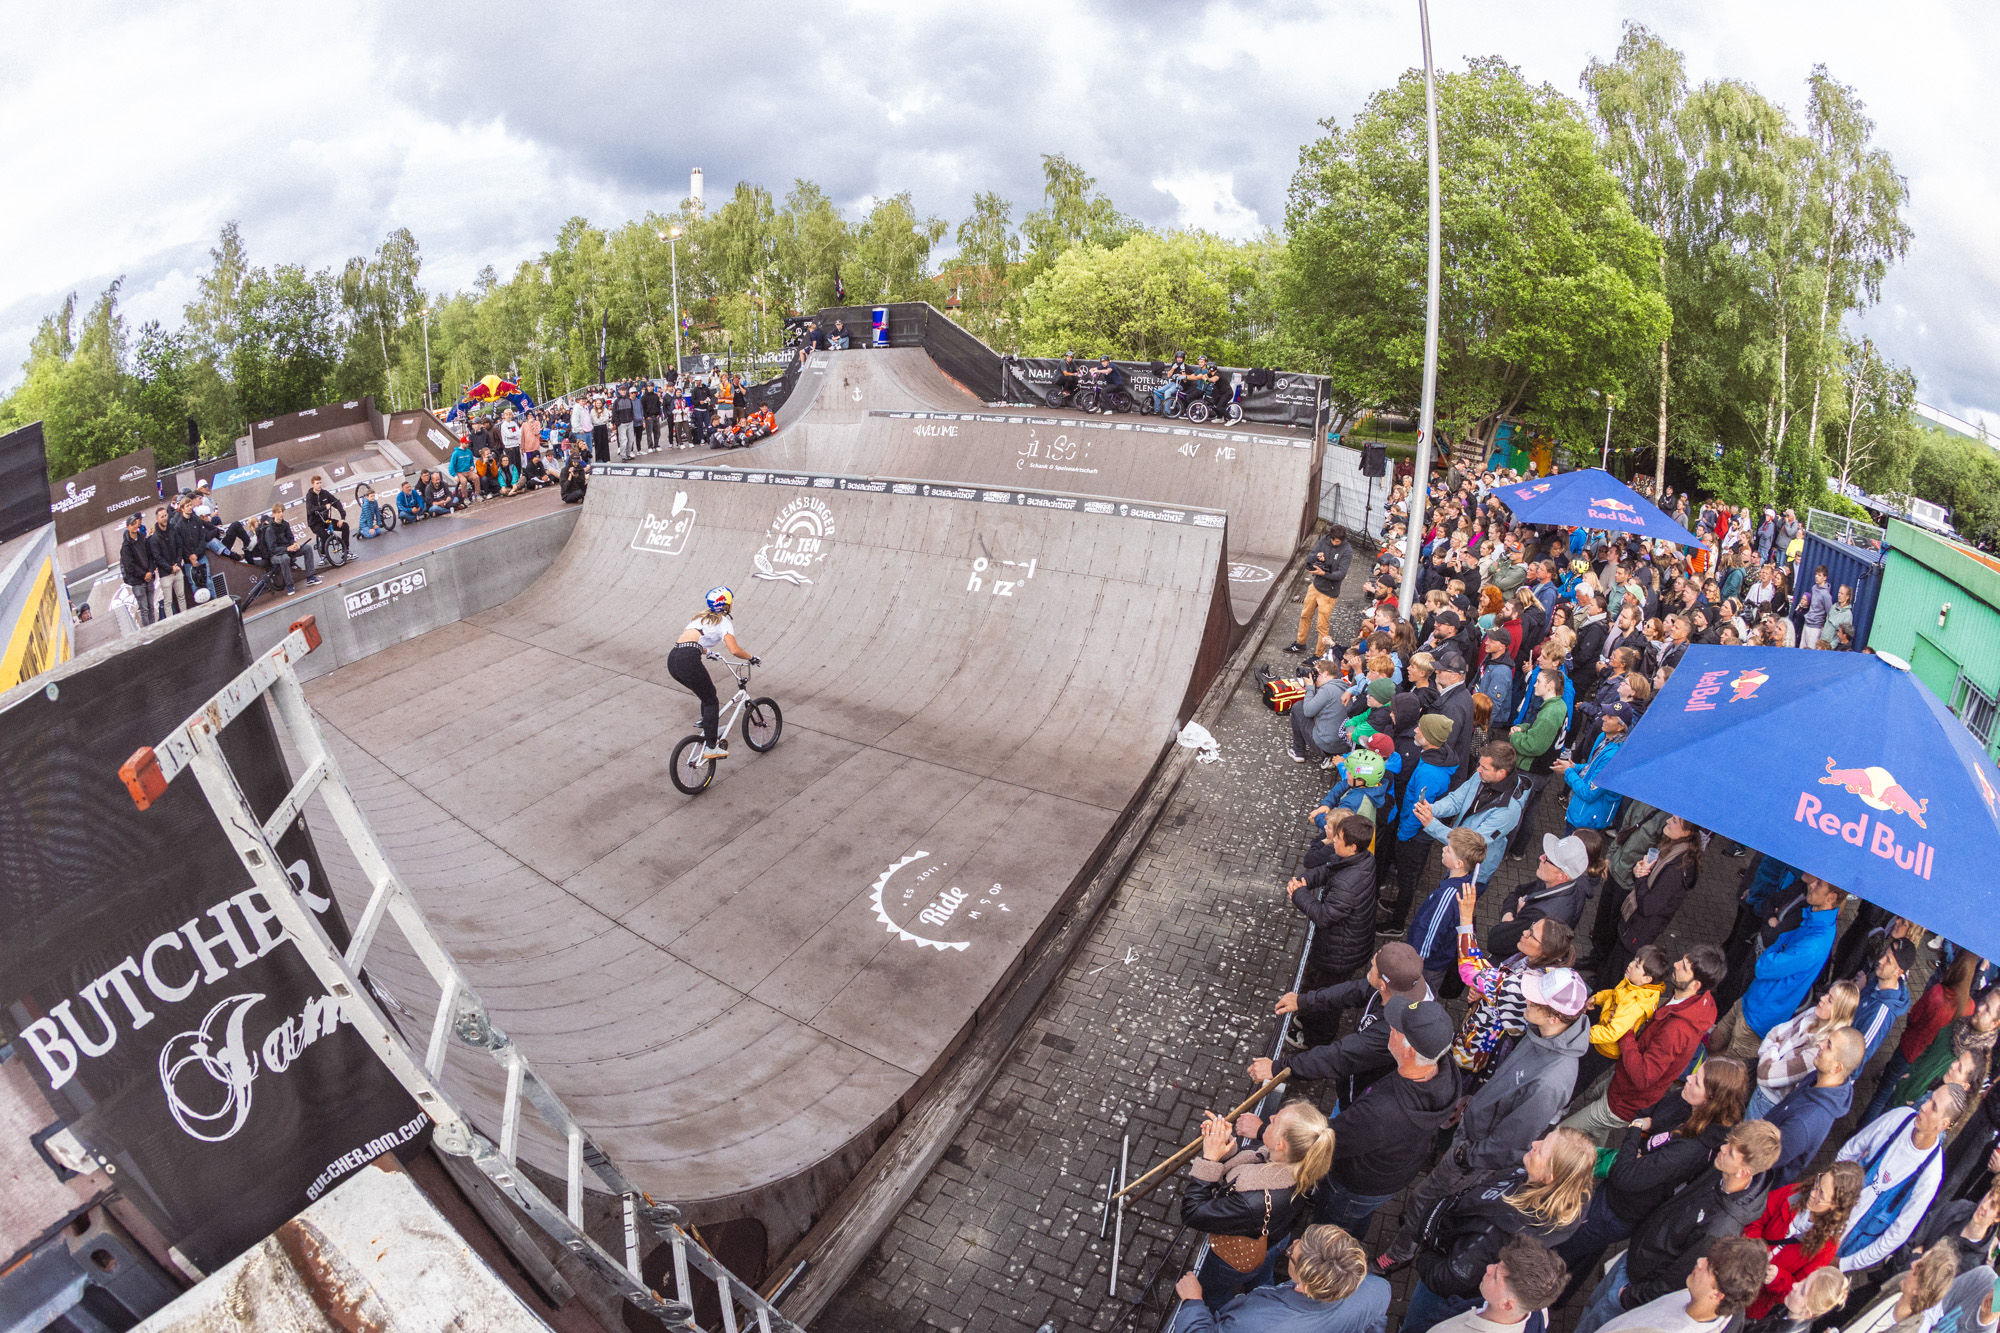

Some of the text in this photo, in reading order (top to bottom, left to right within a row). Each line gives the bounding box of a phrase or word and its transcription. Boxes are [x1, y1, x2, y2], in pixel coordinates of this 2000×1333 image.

[643, 513, 689, 534] Dopel
[771, 496, 835, 537] FLENSBURGER
[1588, 508, 1645, 526] Red Bull
[772, 549, 813, 567] LIMOS
[350, 596, 399, 618] WERBEDESIN
[1684, 670, 1730, 712] Red Bull
[1794, 791, 1935, 880] Red Bull
[919, 886, 969, 927] Ride
[20, 859, 331, 1090] BUTCHER
